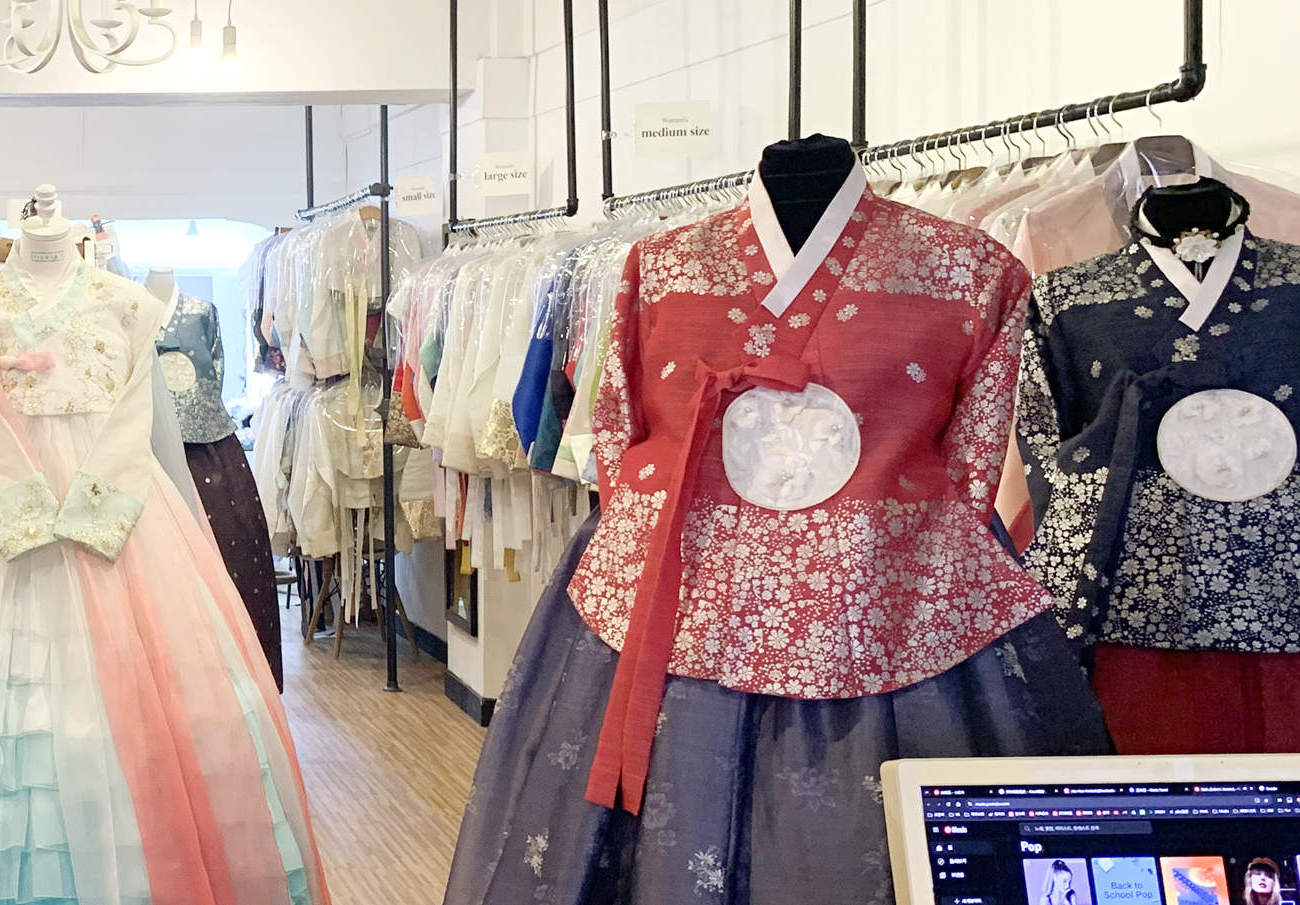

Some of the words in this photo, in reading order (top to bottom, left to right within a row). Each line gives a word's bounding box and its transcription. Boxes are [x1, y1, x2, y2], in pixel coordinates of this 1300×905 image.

[641, 127, 687, 138] medium
[690, 125, 710, 136] size
[484, 171, 508, 181] large
[510, 169, 528, 179] size
[402, 191, 421, 201] small
[1020, 840, 1043, 854] Pop
[1111, 881, 1132, 889] Back
[1134, 881, 1143, 889] to
[1104, 890, 1134, 899] School
[1136, 890, 1153, 899] Pop
